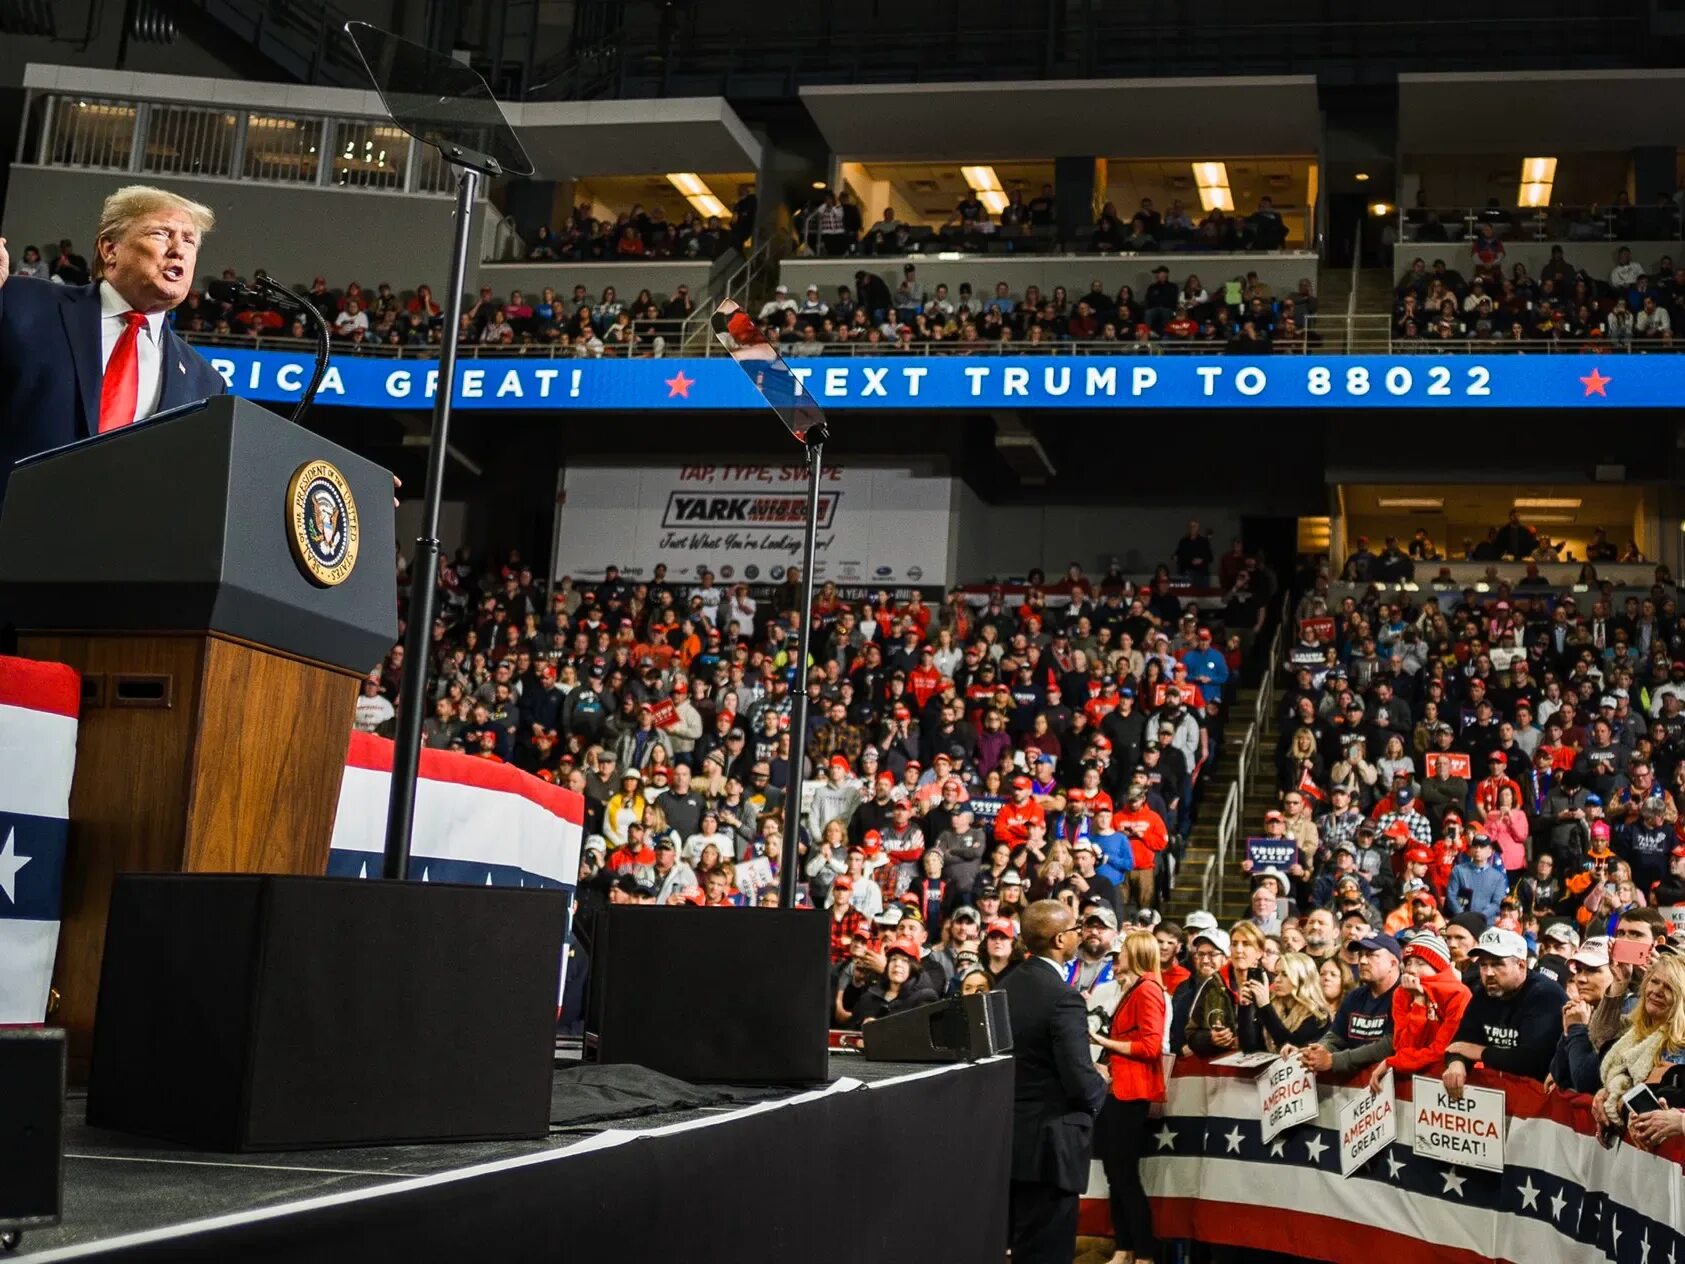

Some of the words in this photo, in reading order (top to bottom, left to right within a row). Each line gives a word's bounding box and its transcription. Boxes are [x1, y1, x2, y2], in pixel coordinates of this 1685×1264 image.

[788, 367, 928, 396] TEXT
[965, 367, 1157, 396] TRUMP
[1197, 367, 1266, 396] TO
[1308, 366, 1491, 395] 88022
[296, 465, 327, 508] PRESIDENT
[679, 464, 714, 484] TAP,
[722, 464, 774, 484] TYPE,
[779, 464, 842, 481] SWPE
[343, 491, 357, 542] UNITED
[674, 498, 751, 521] YARK
[659, 532, 688, 550] Just
[689, 533, 721, 550] What
[725, 533, 758, 549] You're
[760, 533, 803, 556] Looking
[331, 551, 354, 580] STATES
[1250, 846, 1295, 856] TRUMP
[1481, 932, 1501, 944] USA
[1484, 1025, 1519, 1040] TRUMP
[1269, 1066, 1294, 1087] KEEP
[1263, 1077, 1311, 1114] AMERICA
[1353, 1092, 1377, 1119] KEEP
[1437, 1093, 1477, 1113] KEEP
[1270, 1099, 1304, 1127] GREAT!
[1343, 1100, 1392, 1146] AMERICA
[1418, 1108, 1499, 1140] AMERICA
[1351, 1124, 1385, 1158] GREAT!
[1430, 1132, 1486, 1157] GREAT!
